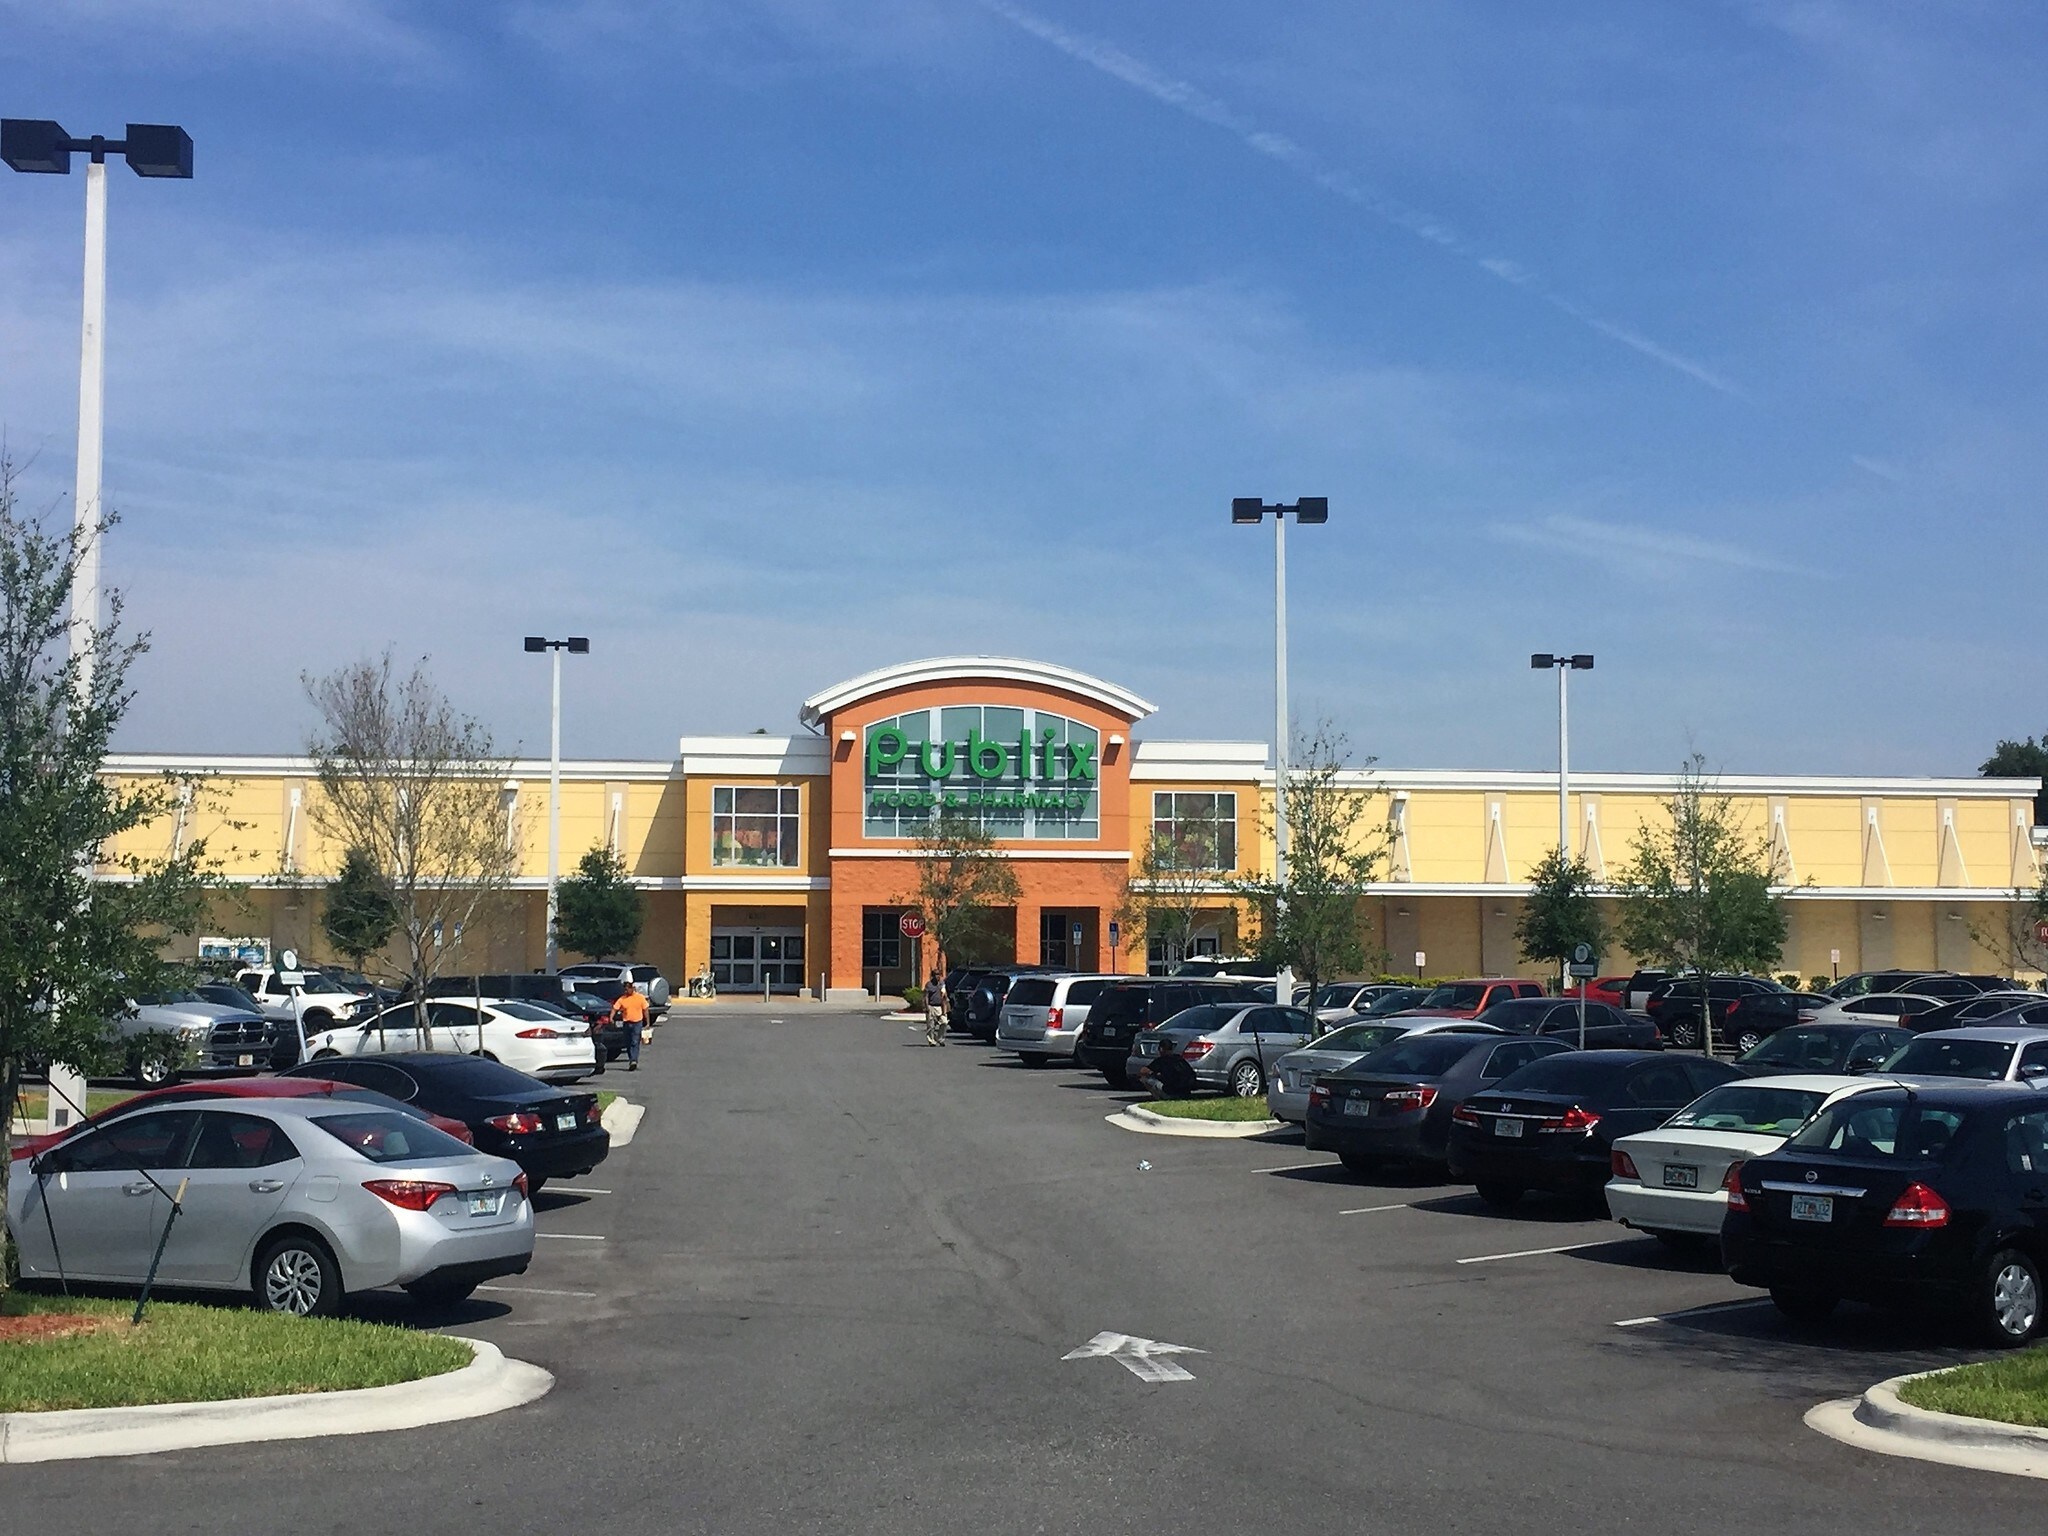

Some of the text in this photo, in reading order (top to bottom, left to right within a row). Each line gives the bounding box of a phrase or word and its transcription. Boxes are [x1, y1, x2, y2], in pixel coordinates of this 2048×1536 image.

[868, 726, 1095, 779] Publix
[872, 792, 1093, 809] FOOD & PHARMACY
[902, 918, 925, 930] STOP
